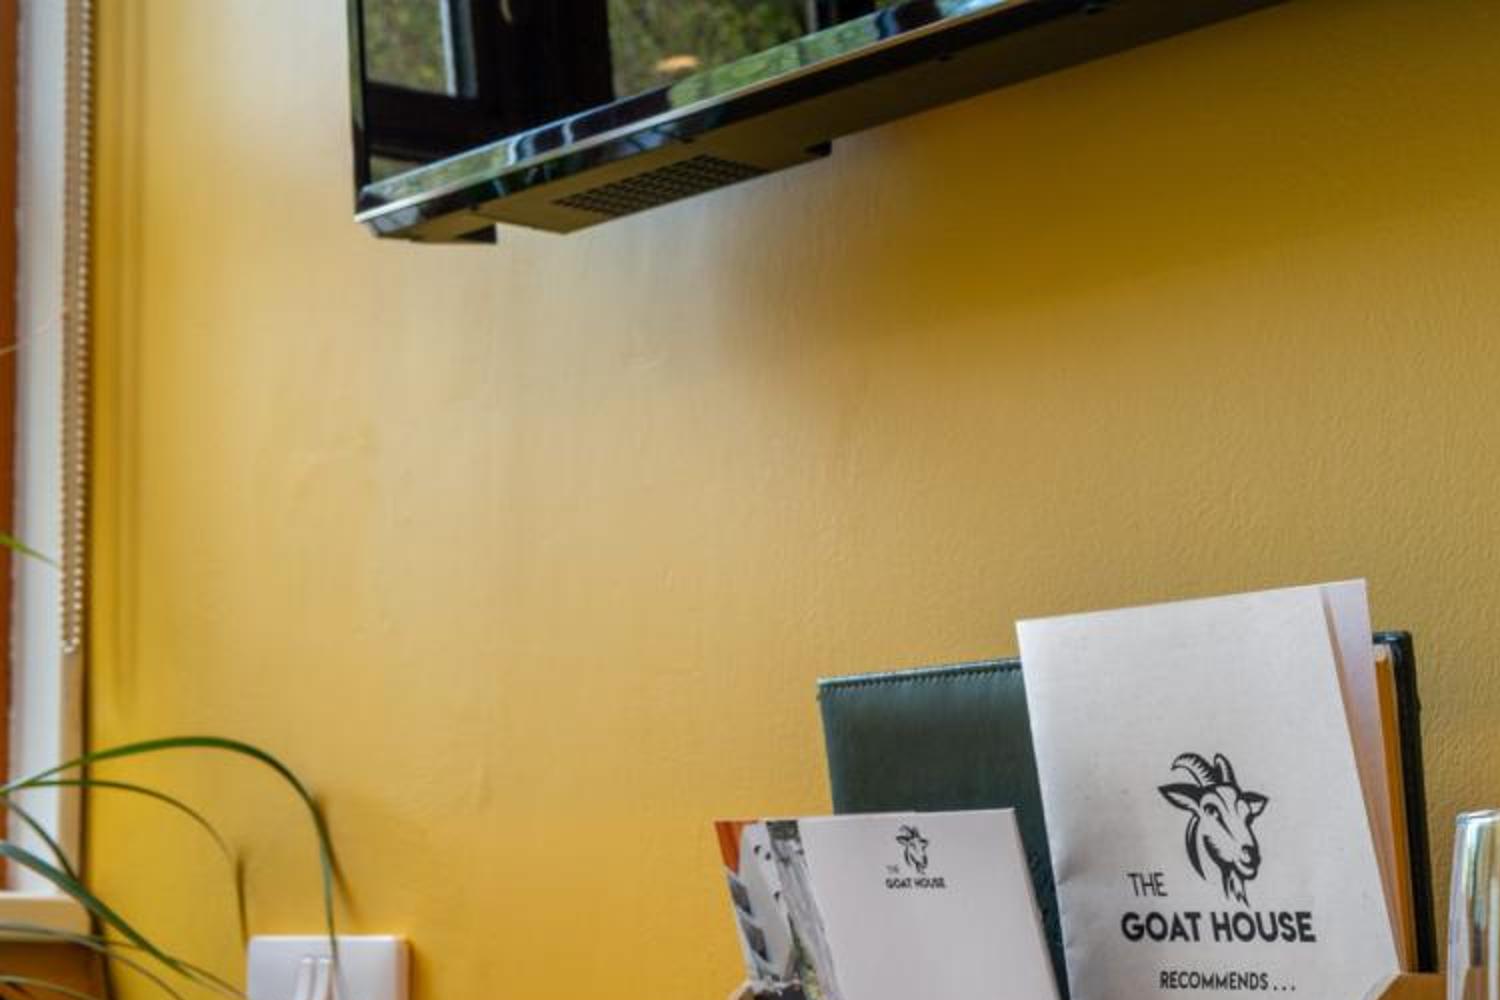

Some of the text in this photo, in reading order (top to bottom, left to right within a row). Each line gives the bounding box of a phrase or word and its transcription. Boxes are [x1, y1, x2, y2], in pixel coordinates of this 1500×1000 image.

[885, 877, 945, 889] GOAT HOUSE
[1127, 872, 1168, 897] THE
[1121, 911, 1316, 942] GOAT HOUSE
